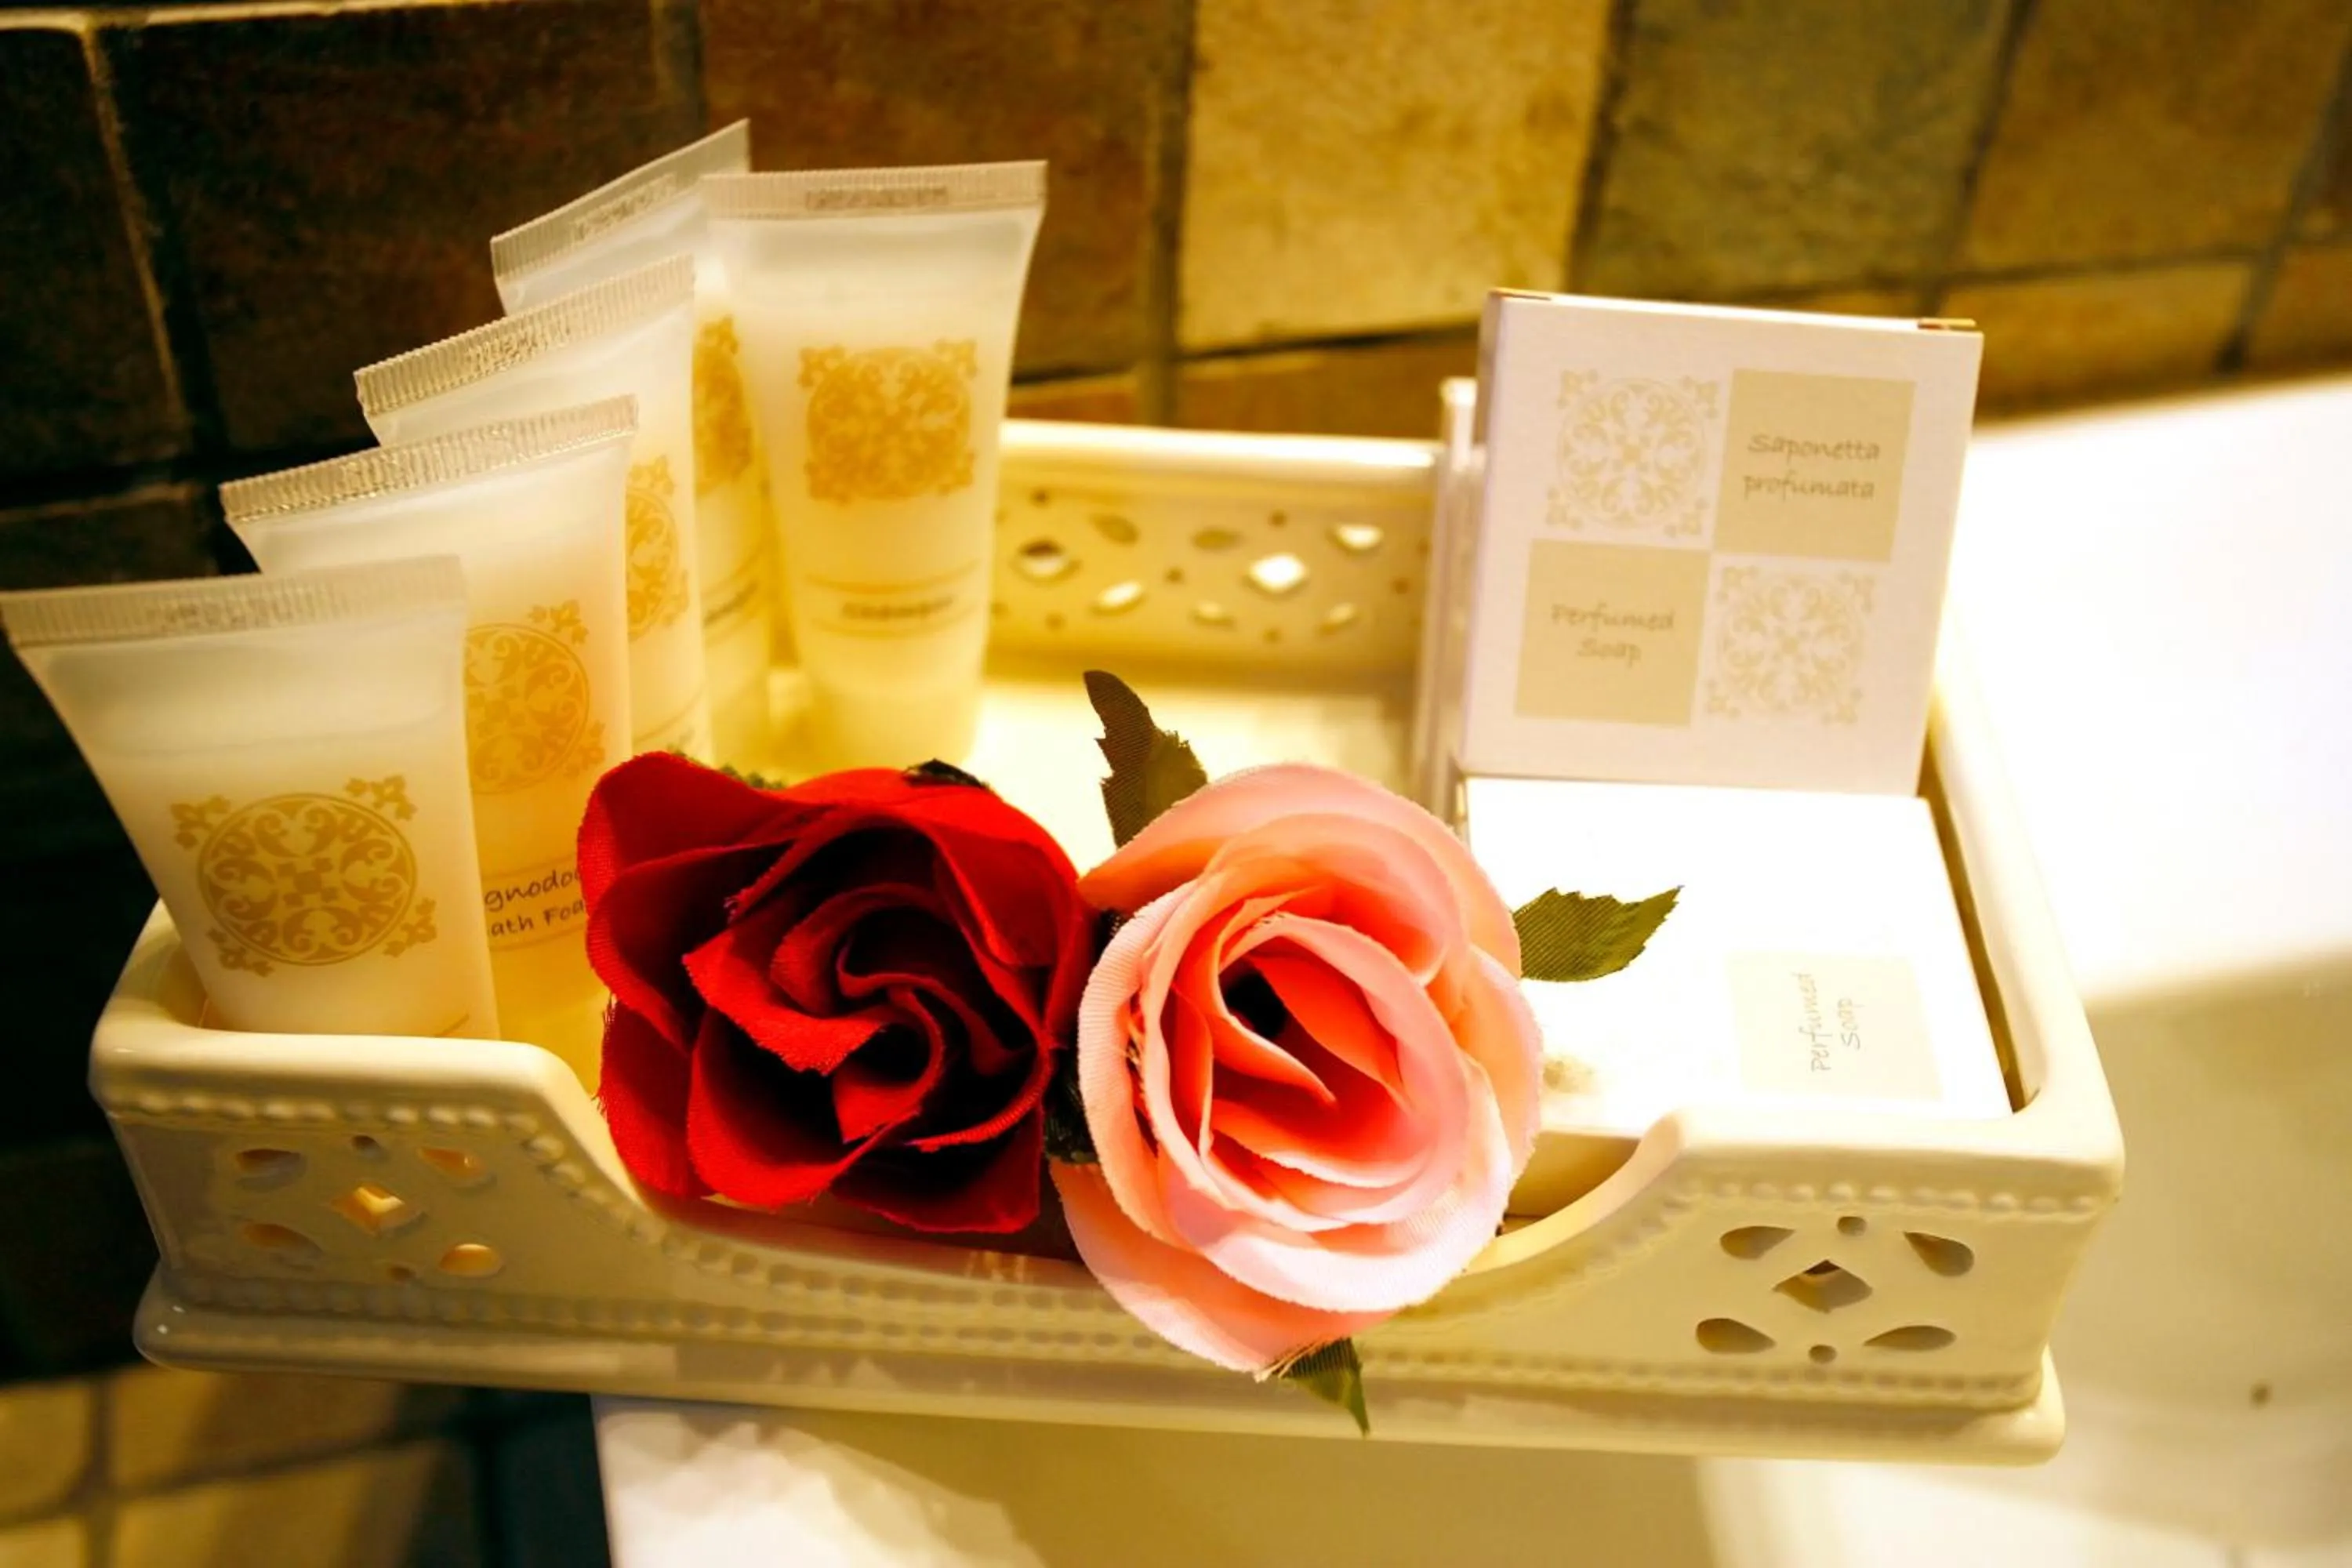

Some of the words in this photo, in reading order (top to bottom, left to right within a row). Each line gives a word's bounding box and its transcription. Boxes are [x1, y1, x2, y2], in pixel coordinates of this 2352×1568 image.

[1747, 434, 1881, 466] Saponetta
[1742, 468, 1876, 503] profumata
[1551, 598, 1676, 633] Perfumed
[1576, 637, 1642, 670] Soap
[484, 868, 581, 913] gnodo
[490, 914, 535, 938] ath
[543, 898, 586, 927] Foa
[1791, 971, 1832, 1072] Perfumed
[1836, 997, 1866, 1051] Soap
